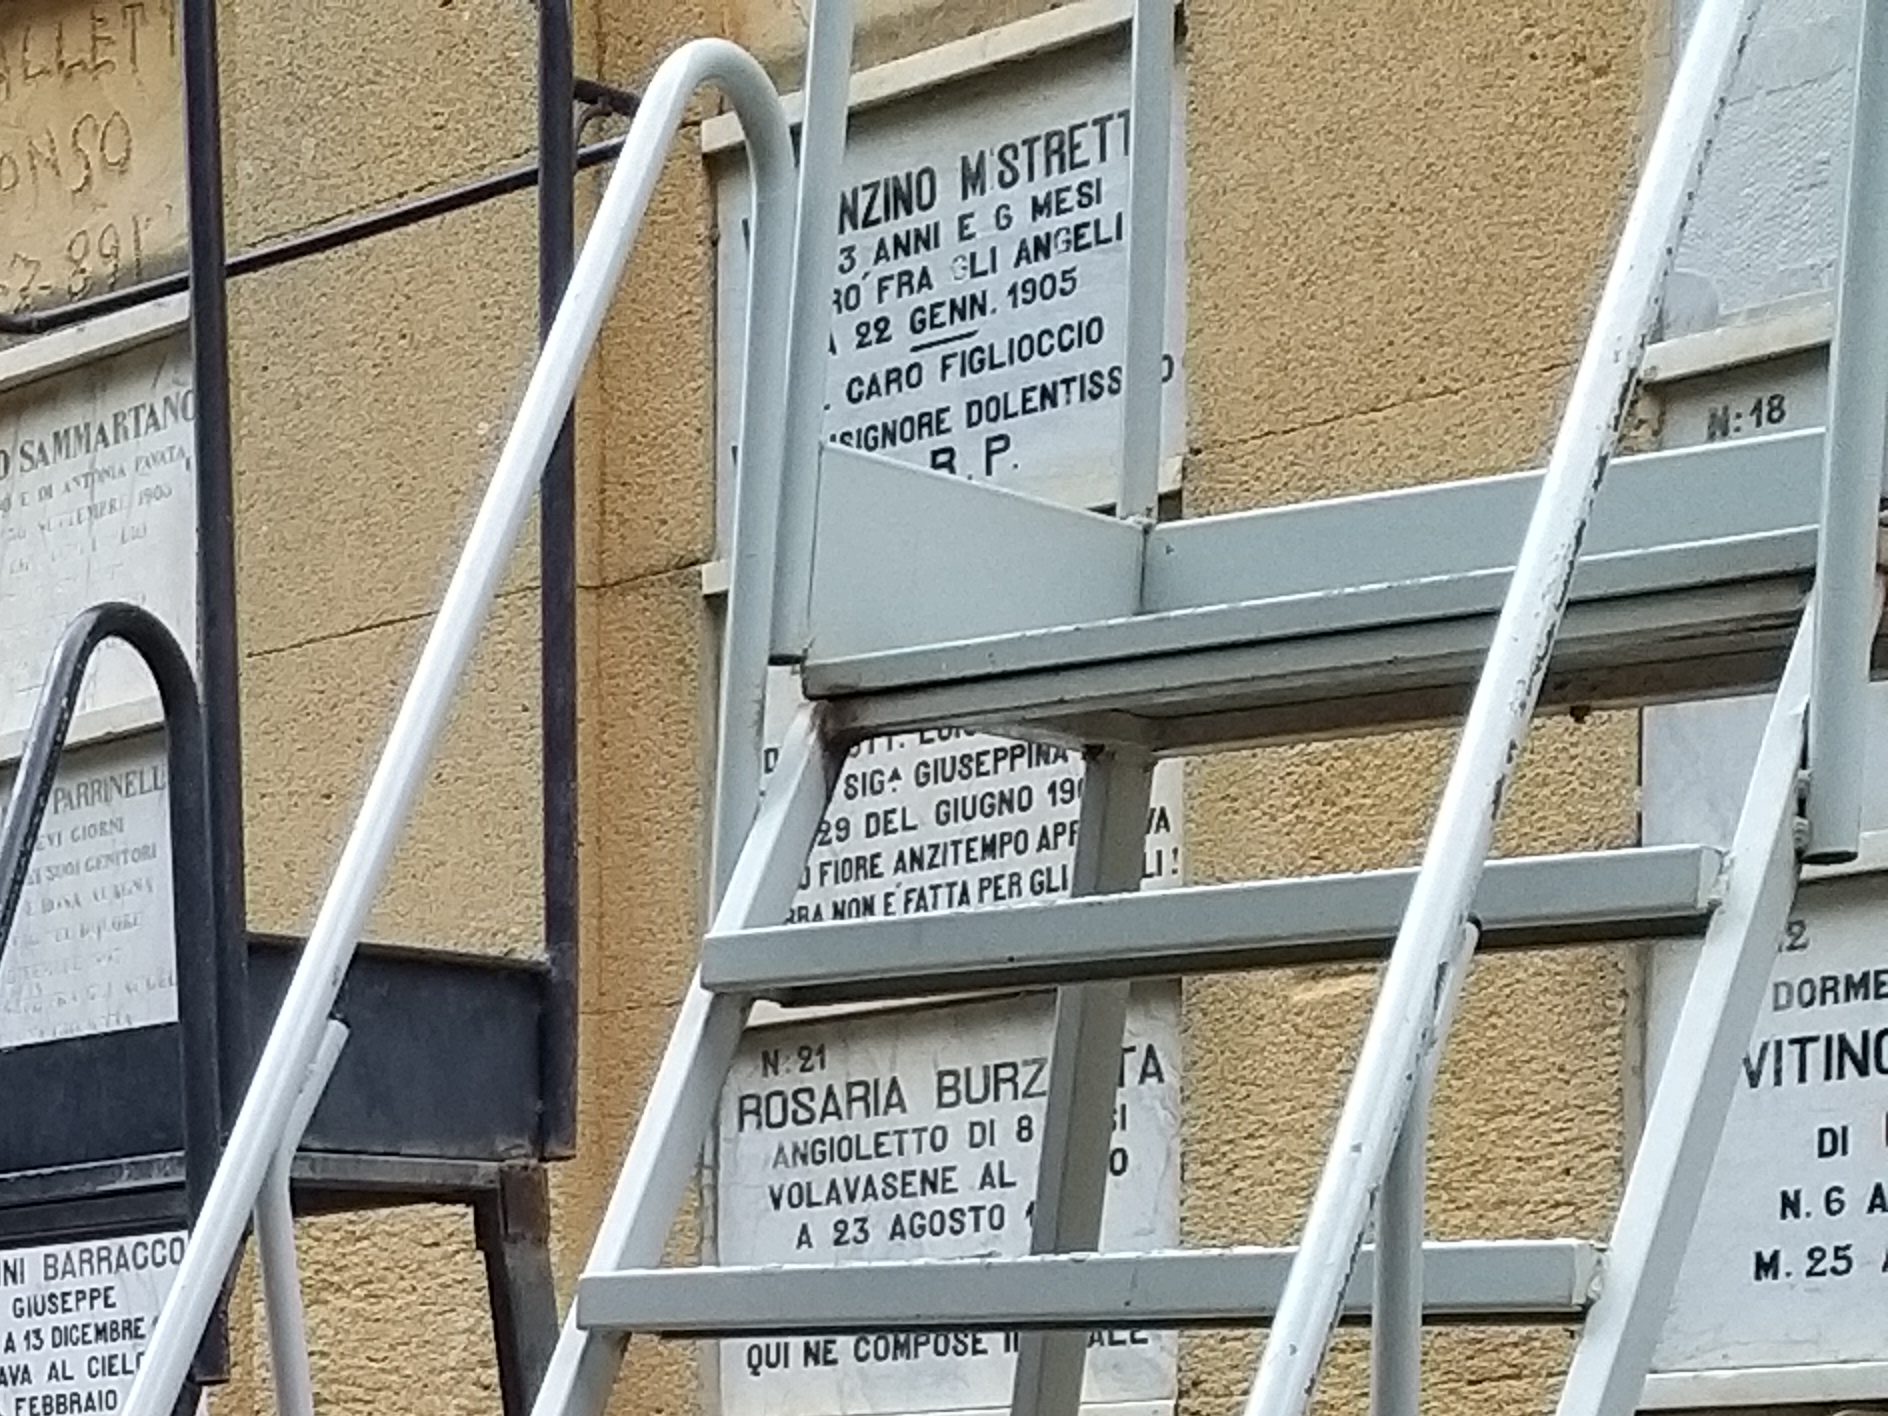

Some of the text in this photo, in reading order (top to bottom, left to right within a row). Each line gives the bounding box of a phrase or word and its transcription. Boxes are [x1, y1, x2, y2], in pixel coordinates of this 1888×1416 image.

[838, 109, 1131, 234] NZINO MSTRETT
[838, 178, 1102, 274] 3 ANNI E MESI
[877, 212, 1124, 304] FRA GLI ANGELI
[855, 267, 1078, 349] 22 GENN. 1905
[846, 316, 1104, 404] CARO FIGLIOCCIO
[915, 739, 1068, 788] GIUSEPPINA
[818, 786, 1033, 847] 29 DEL GIUGNO
[819, 829, 1028, 887] FIORE ANZITEMPO
[904, 863, 1067, 913] FATTA PER GLI
[738, 1075, 907, 1131] ROSARIA
[773, 1115, 1033, 1169] ANGIOLETTO DI 8
[1817, 1126, 1849, 1158] DI
[769, 1160, 1017, 1210] VOLAVASENE AL
[1825, 1187, 1844, 1215] 6
[796, 1205, 1005, 1249] A 23 AGOSTO
[43, 1236, 185, 1282] BARRACCO
[1805, 1244, 1853, 1278] 25
[13, 1287, 117, 1318] GIUSEPPE
[3, 1318, 146, 1354] A 13 DICEMBRE
[747, 1332, 988, 1375] QUI NE COMPOSE
[48, 1359, 73, 1382] AL
